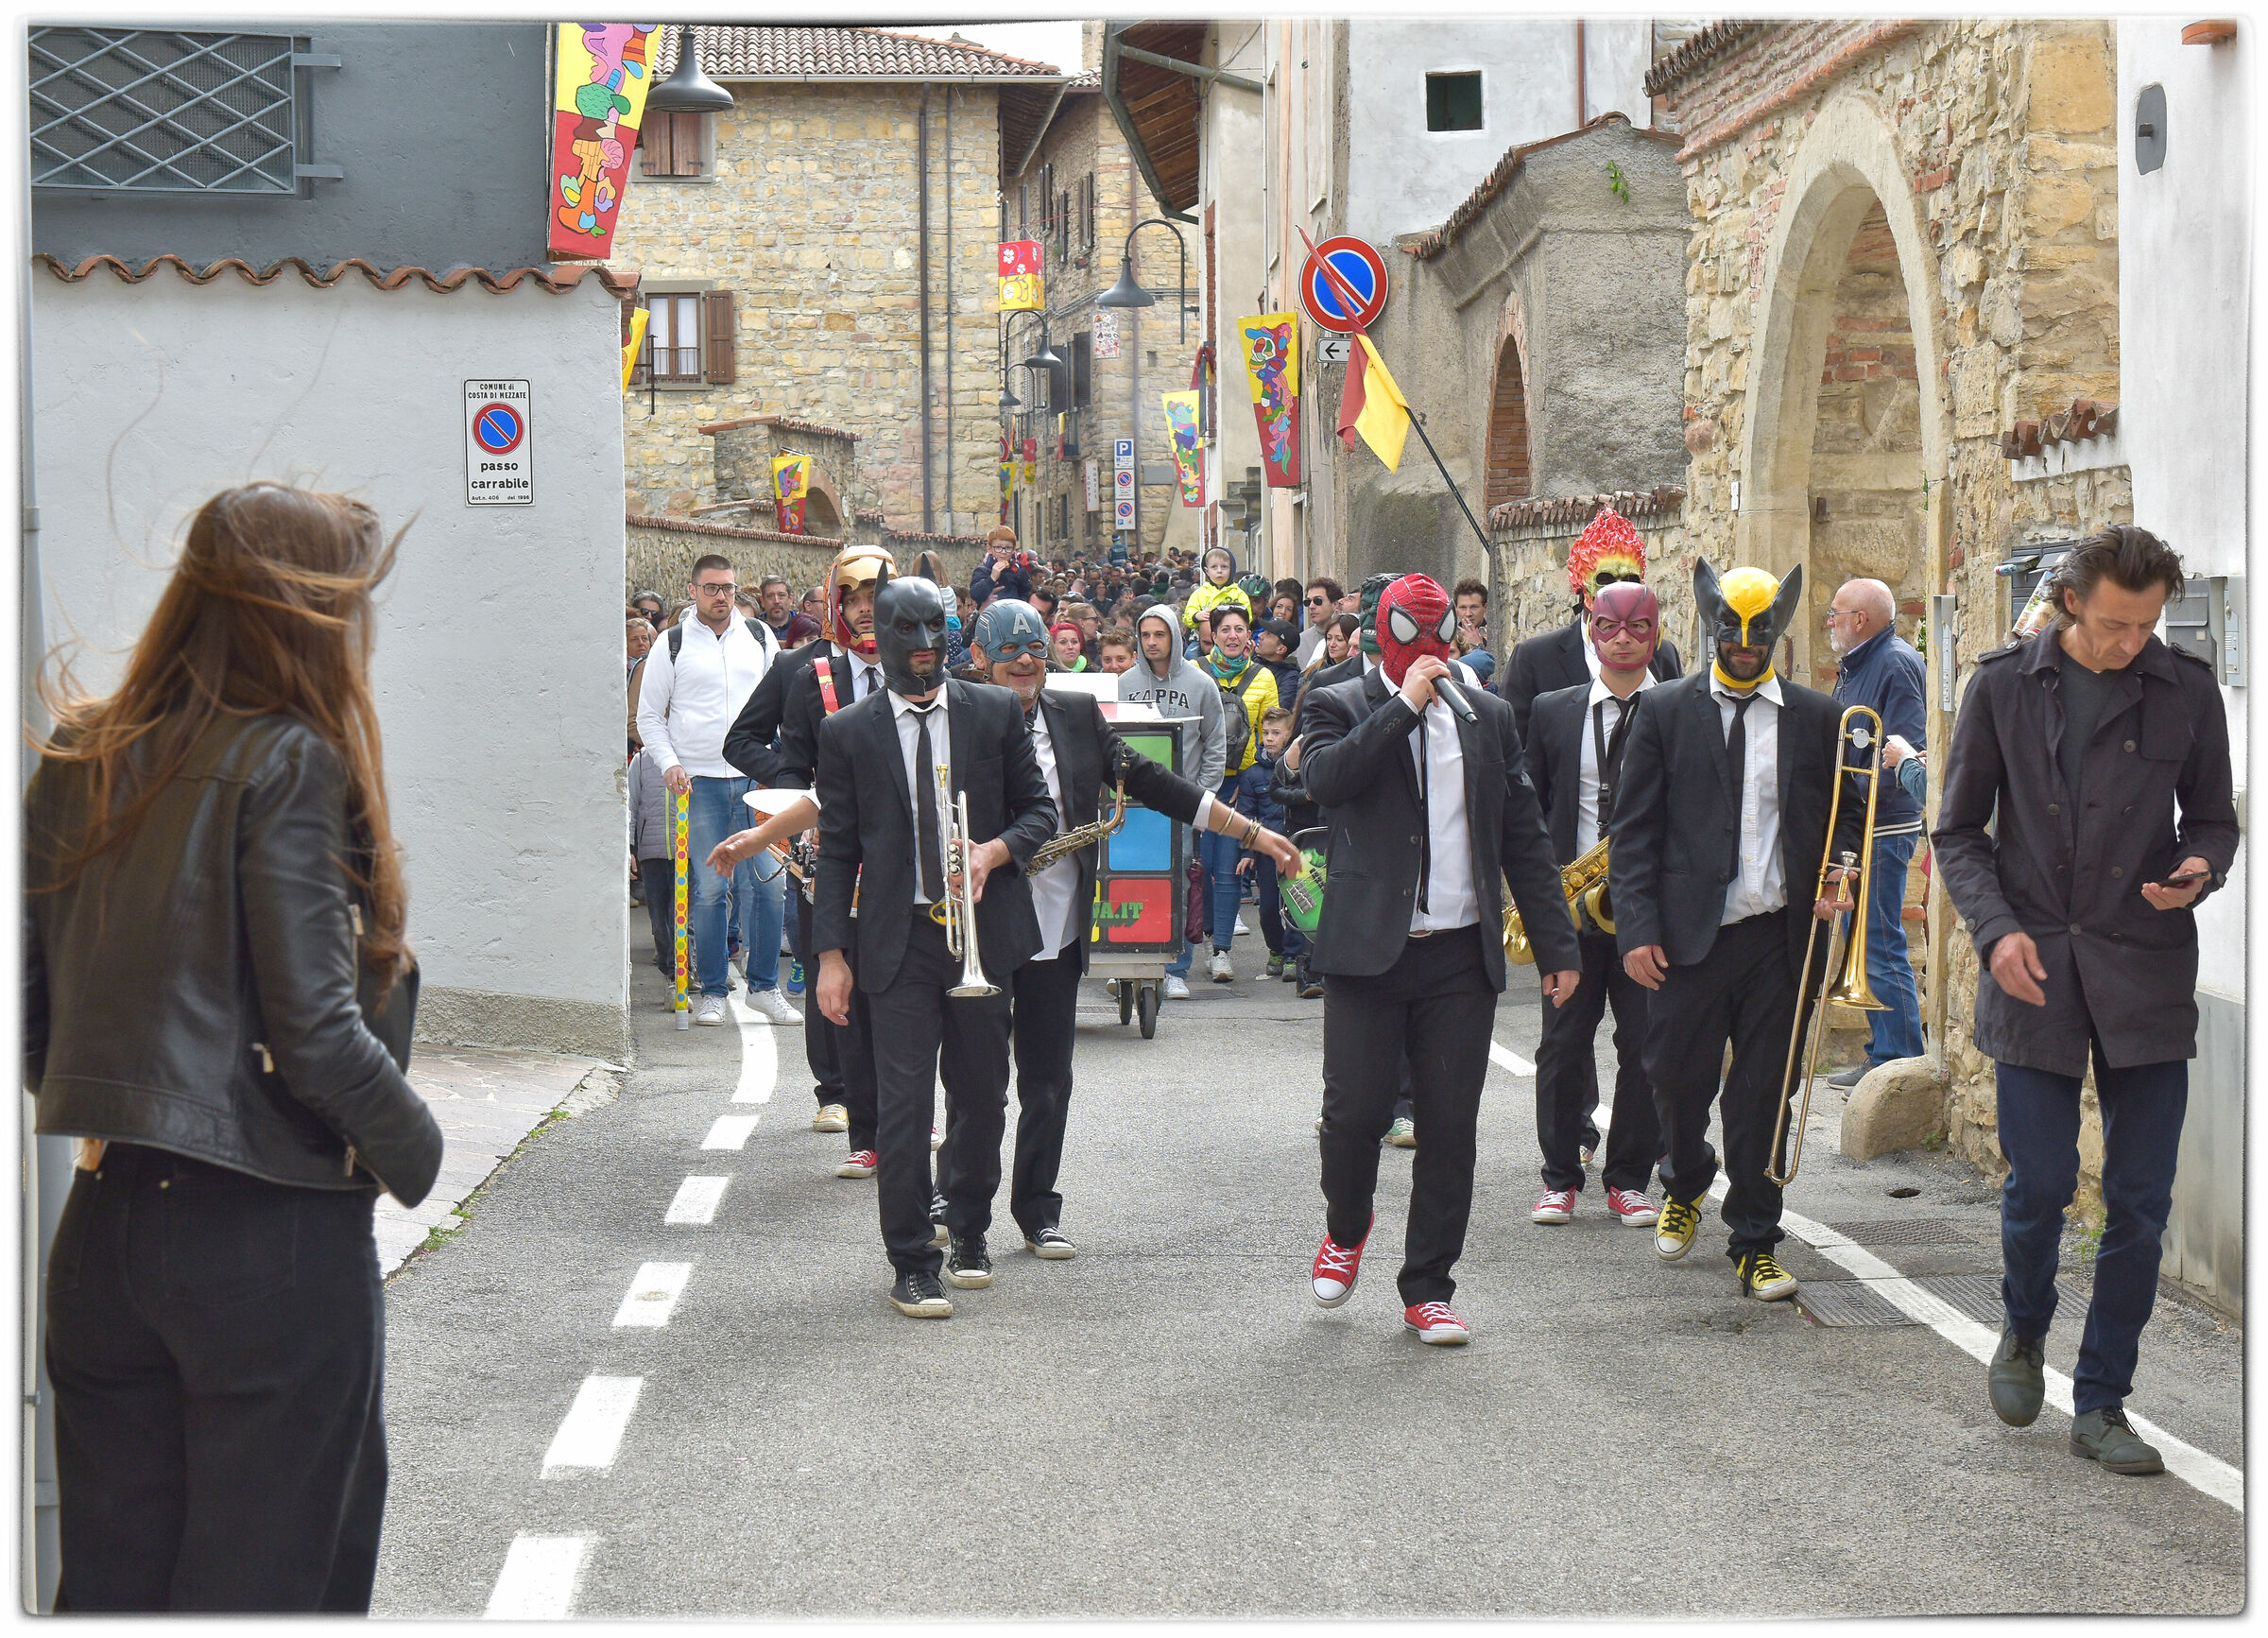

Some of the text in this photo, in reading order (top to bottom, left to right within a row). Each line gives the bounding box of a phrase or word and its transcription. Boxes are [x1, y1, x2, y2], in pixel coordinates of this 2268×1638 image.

[1119, 442, 1128, 455] P
[480, 462, 519, 473] passo
[471, 478, 529, 489] carrabile
[1012, 612, 1033, 635] A
[1128, 688, 1190, 710] KAPPA
